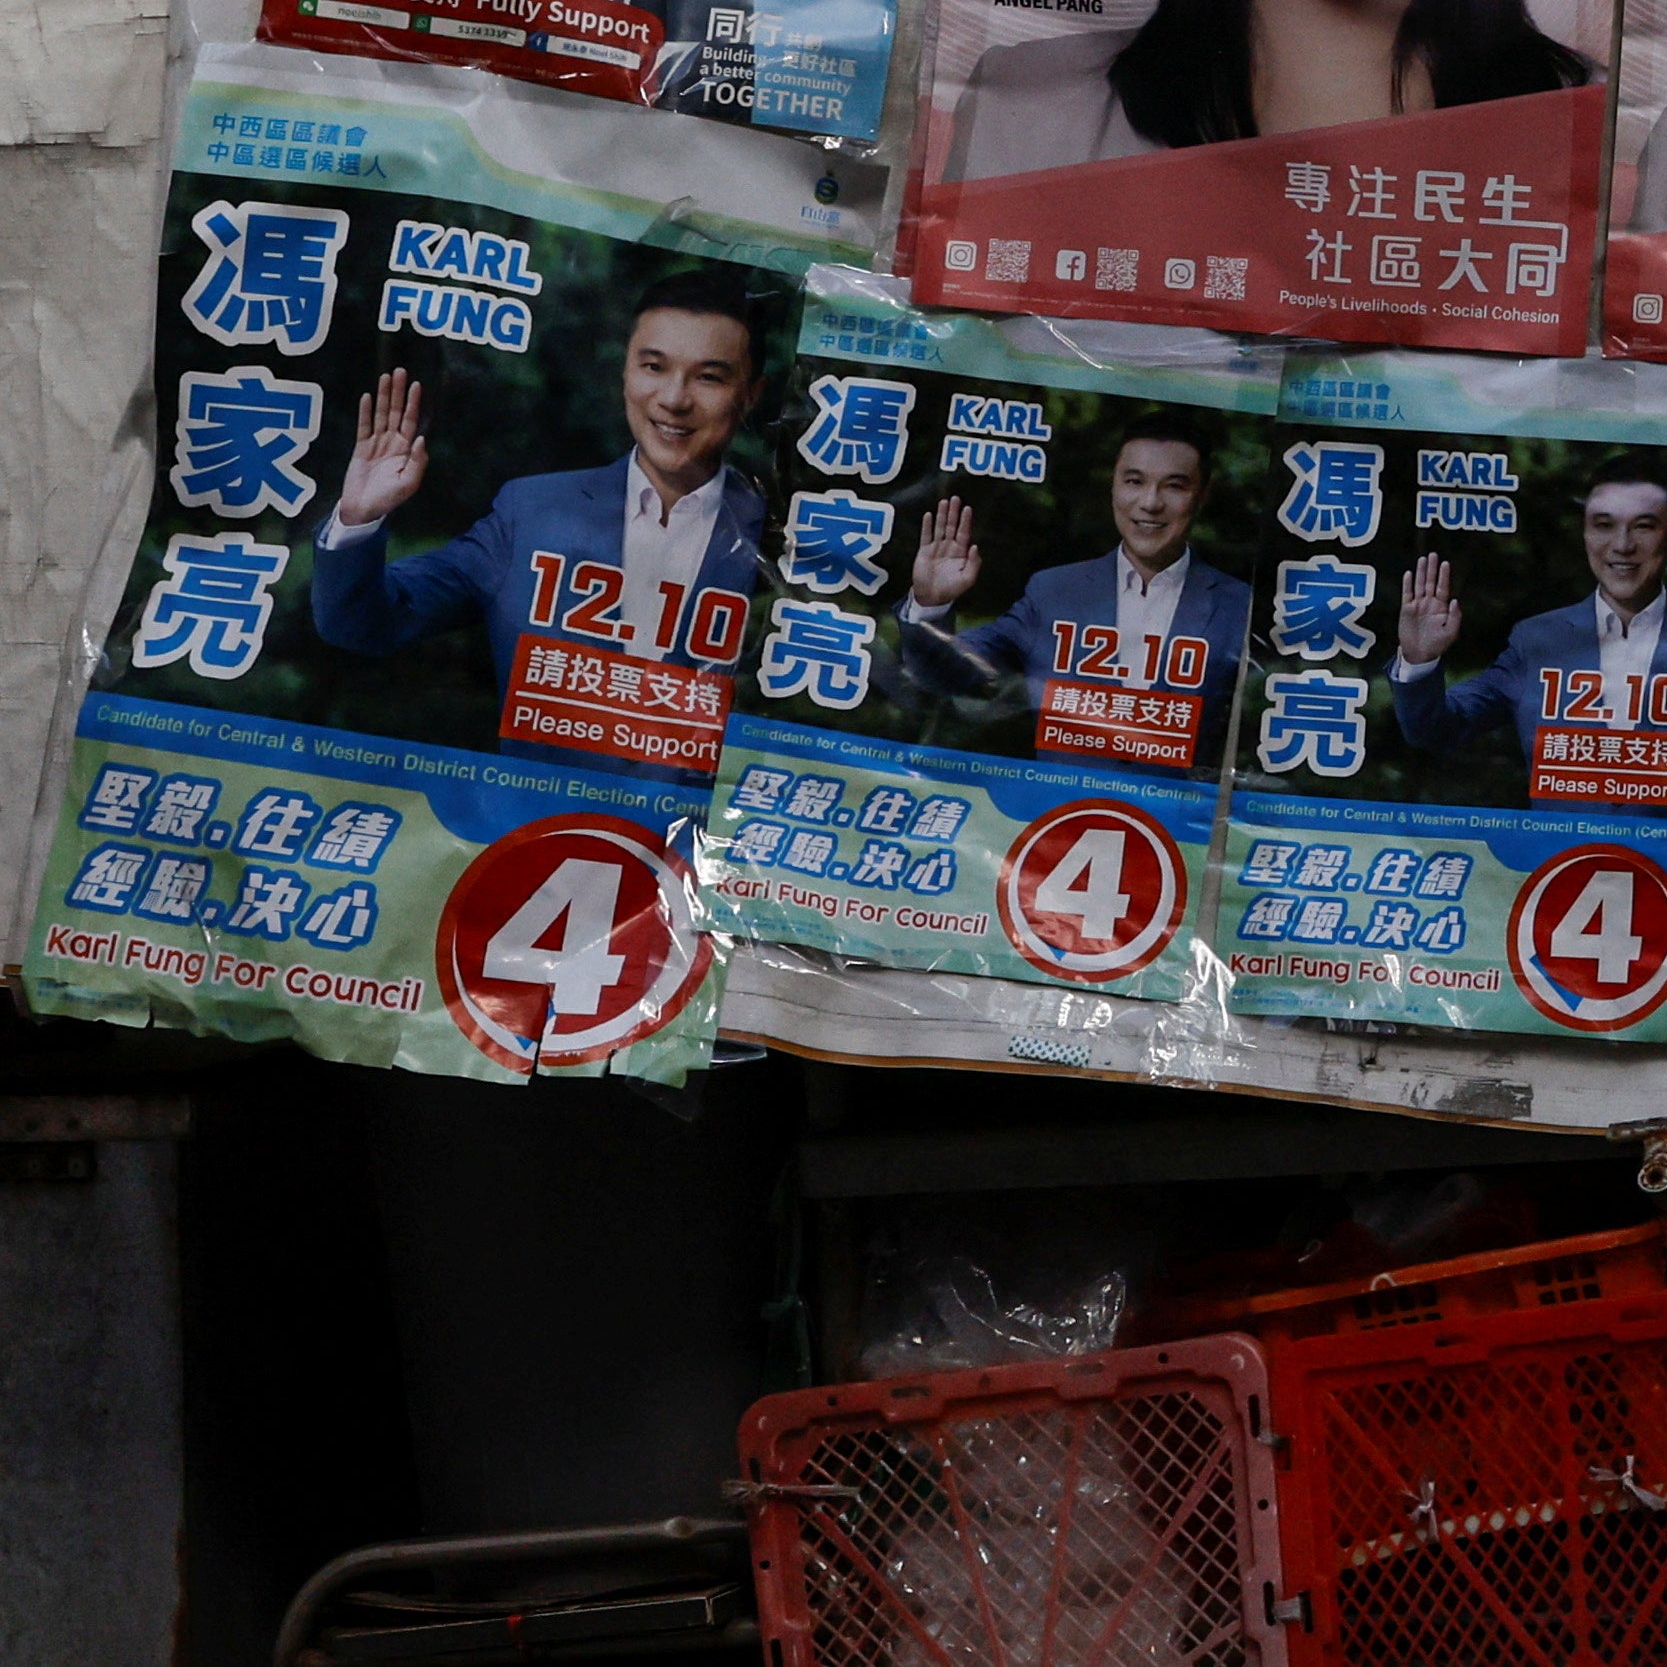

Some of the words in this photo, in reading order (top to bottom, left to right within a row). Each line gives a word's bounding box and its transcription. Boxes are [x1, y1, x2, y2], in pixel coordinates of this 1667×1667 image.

[546, 0, 651, 46] Support
[705, 6, 785, 48] 同行
[702, 45, 767, 69] Building
[712, 61, 760, 82] better
[764, 71, 852, 98] community
[210, 112, 369, 149] 中西區區議會
[700, 80, 844, 122] TOGETHER
[205, 141, 389, 180] 中區選區候選人
[1284, 161, 1545, 227] 專注民生
[394, 224, 538, 292] KARL
[1304, 227, 1562, 298] 社區大同
[382, 281, 531, 349] FUNG
[1279, 289, 1338, 312] People's
[1339, 296, 1428, 317] Livelihoods
[1441, 302, 1488, 321] Social
[1490, 305, 1560, 325] Cohesion
[133, 198, 350, 680] 馮家亮
[949, 392, 1052, 442] KARL
[939, 434, 1049, 484] FUNG
[1417, 449, 1520, 492] KARL
[1415, 490, 1517, 533] FUNG
[756, 373, 917, 711] 馮家亮
[529, 548, 751, 667] 12.10
[1256, 439, 1385, 779] 馮家亮
[528, 644, 726, 720] 請投票支持
[1052, 619, 1210, 689] 12.10
[513, 704, 606, 742] Please
[611, 721, 721, 764] Support
[1052, 685, 1195, 729] 請投票支持
[1537, 774, 1598, 796] Please
[1034, 827, 1132, 941] 4
[482, 856, 628, 1017] 4
[1550, 870, 1643, 986] 4
[46, 927, 116, 964] Karl
[125, 938, 205, 986] Fung
[214, 953, 276, 991] For
[280, 965, 426, 1014] Council
